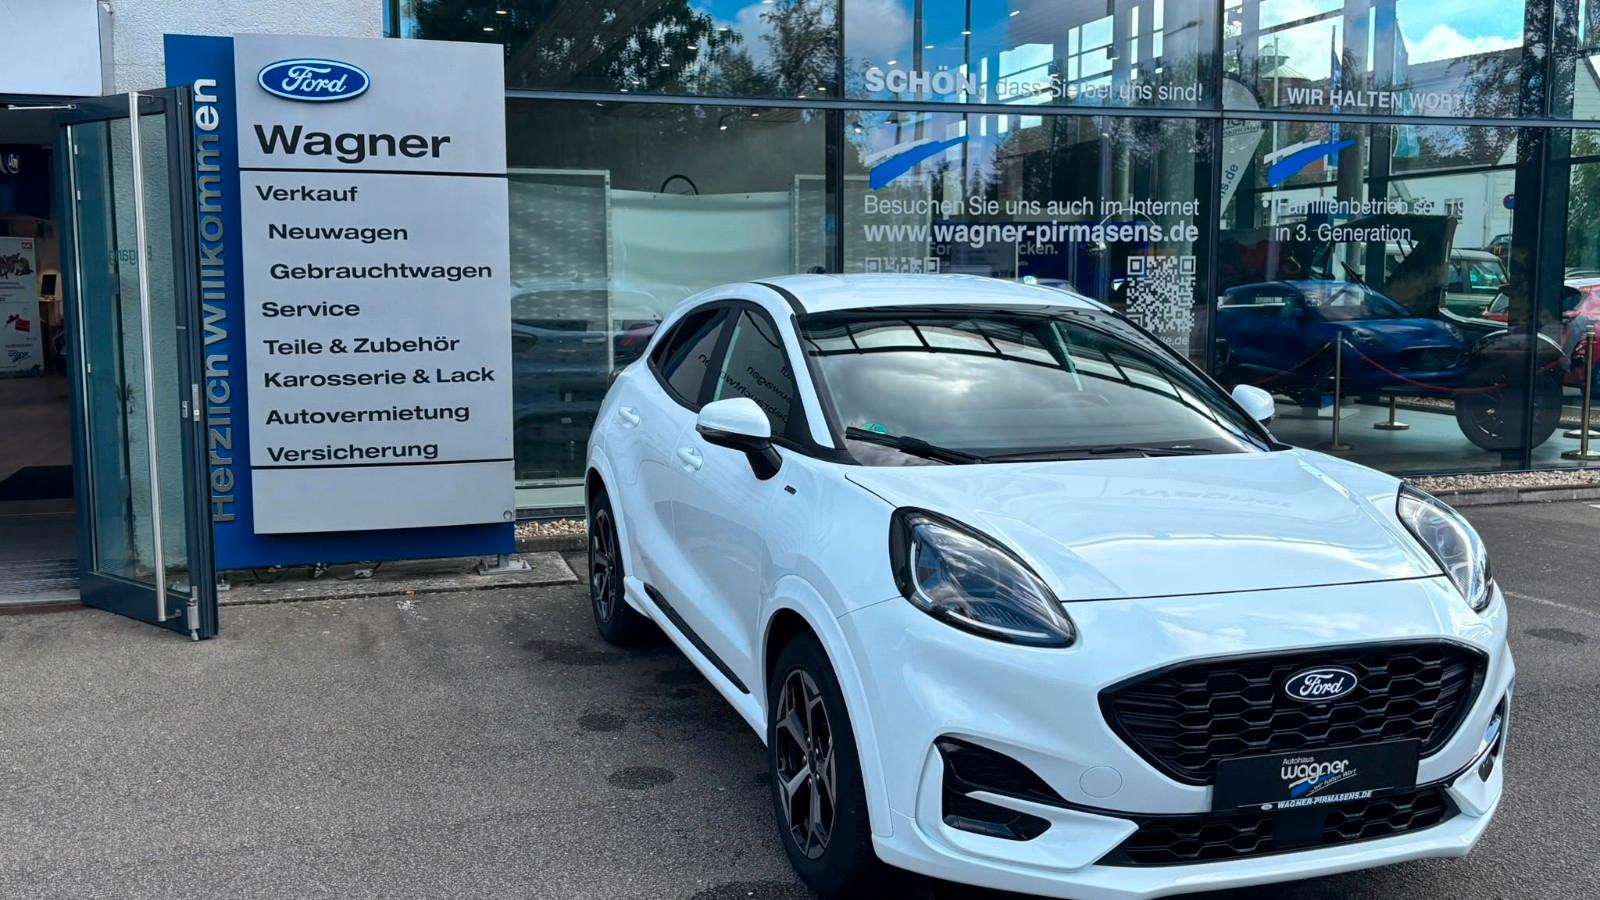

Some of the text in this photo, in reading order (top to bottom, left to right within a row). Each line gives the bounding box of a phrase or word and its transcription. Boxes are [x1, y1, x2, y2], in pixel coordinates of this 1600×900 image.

[281, 65, 348, 93] Ford
[995, 77, 1041, 97] dass
[1050, 76, 1078, 99] Sie
[1085, 81, 1113, 99] bei
[1119, 84, 1153, 100] uns
[1158, 81, 1203, 101] sind!
[1287, 87, 1324, 106] WIR
[1329, 89, 1407, 109] HALTEN
[253, 124, 451, 164] Wagner
[256, 185, 358, 202] Verkauf
[864, 194, 1200, 217] Besuchen Sie uns auch im Internet
[268, 223, 408, 244] Neuwagen
[863, 219, 1199, 249] www.wagner-pirmasens.de
[1275, 223, 1412, 243] in 3. Generation
[270, 262, 492, 282] Gebrauchtwagen
[261, 301, 361, 318] Service
[263, 336, 460, 356] Teile & Zubehör
[264, 366, 496, 388] Karosserie & Lack
[265, 405, 470, 426] Autovermietung
[266, 443, 439, 463] Versicherung
[1299, 672, 1345, 697] Ford
[1281, 756, 1315, 766] Autohaus
[1281, 760, 1349, 784] wagner
[1277, 790, 1373, 809] WAGNER-PIRMASENS.DE
